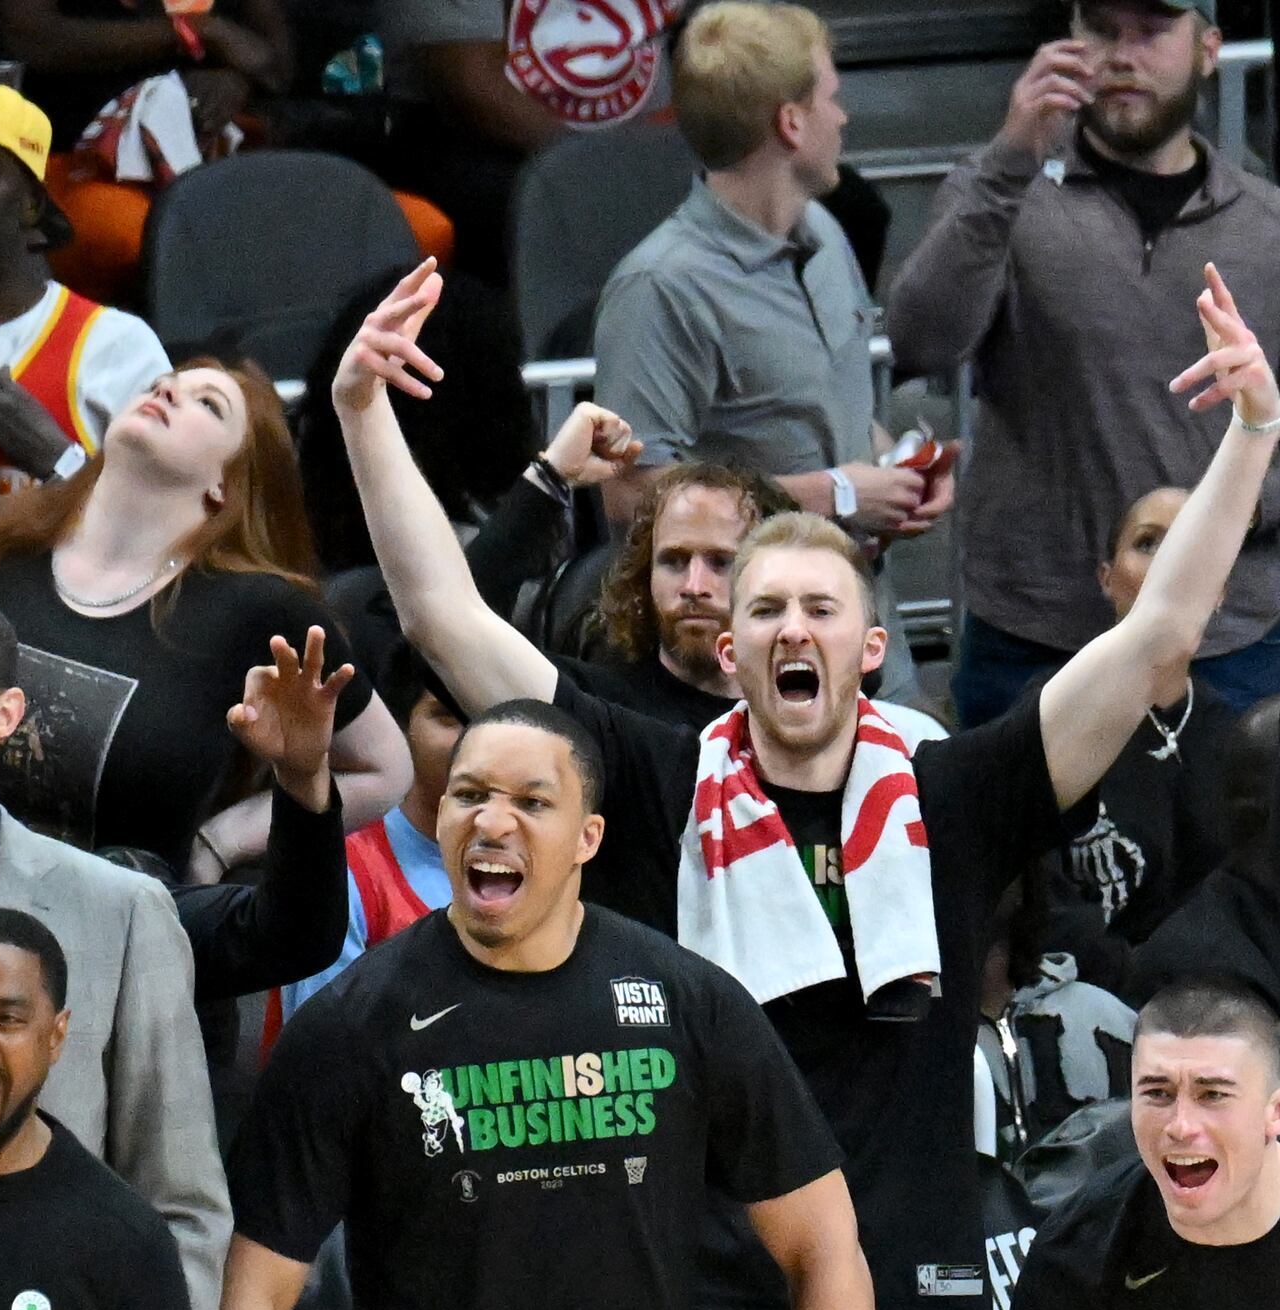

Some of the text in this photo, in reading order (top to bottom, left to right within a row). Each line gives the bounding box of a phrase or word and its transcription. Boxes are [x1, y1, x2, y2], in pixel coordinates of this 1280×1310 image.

[613, 981, 664, 1006] VISTA
[618, 1005, 666, 1024] PRINT
[441, 1047, 676, 1109] UNFINISHED
[467, 1092, 657, 1151] BUSINESS
[496, 1163, 607, 1184] BOSTON CELTICS
